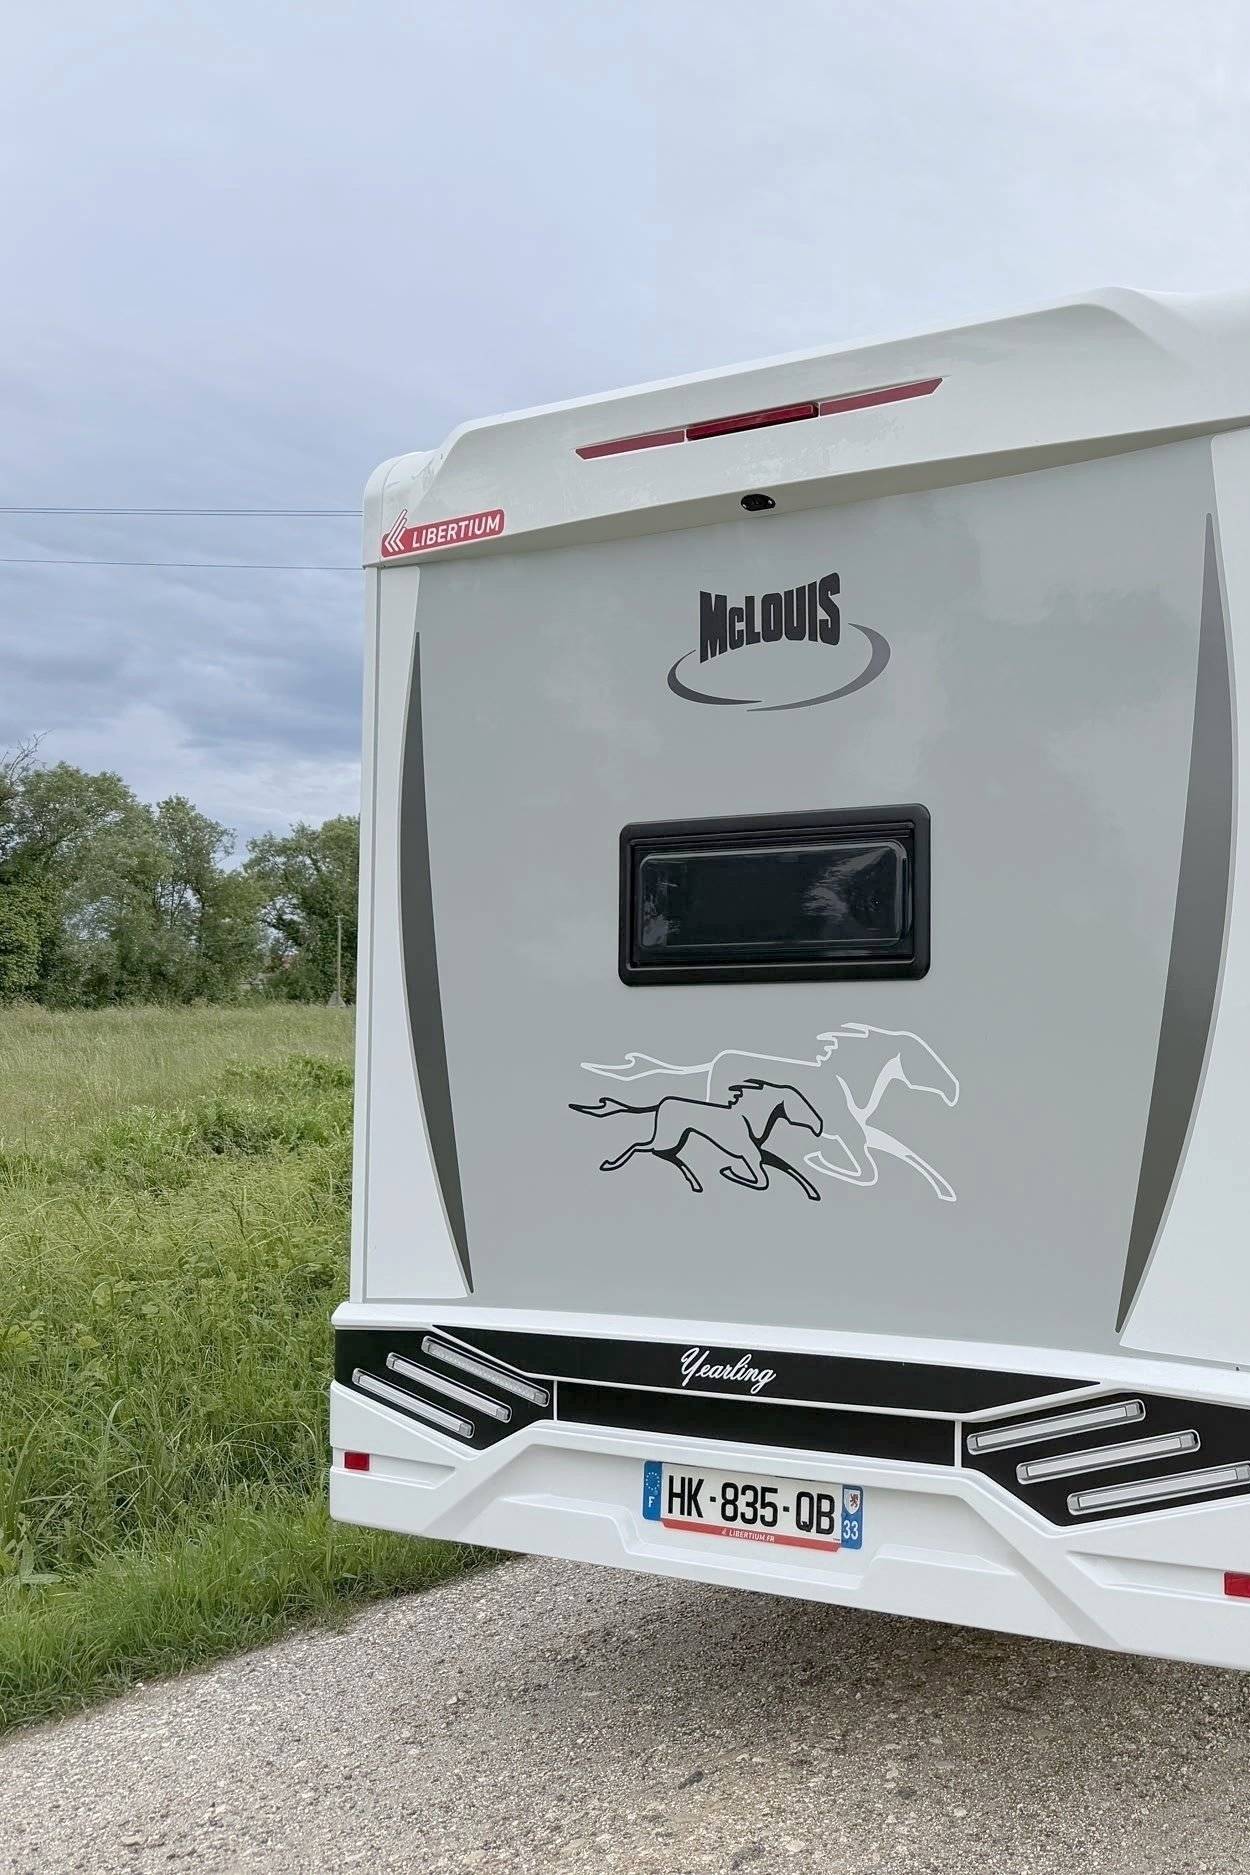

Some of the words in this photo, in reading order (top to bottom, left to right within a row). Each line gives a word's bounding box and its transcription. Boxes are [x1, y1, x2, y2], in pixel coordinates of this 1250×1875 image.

[412, 513, 501, 548] LIBERTIUM
[699, 572, 841, 663] McLOUIS
[680, 1347, 777, 1394] Yearling
[647, 1495, 655, 1508] F
[667, 1474, 836, 1535] HK-835-QB
[843, 1519, 859, 1540] 33
